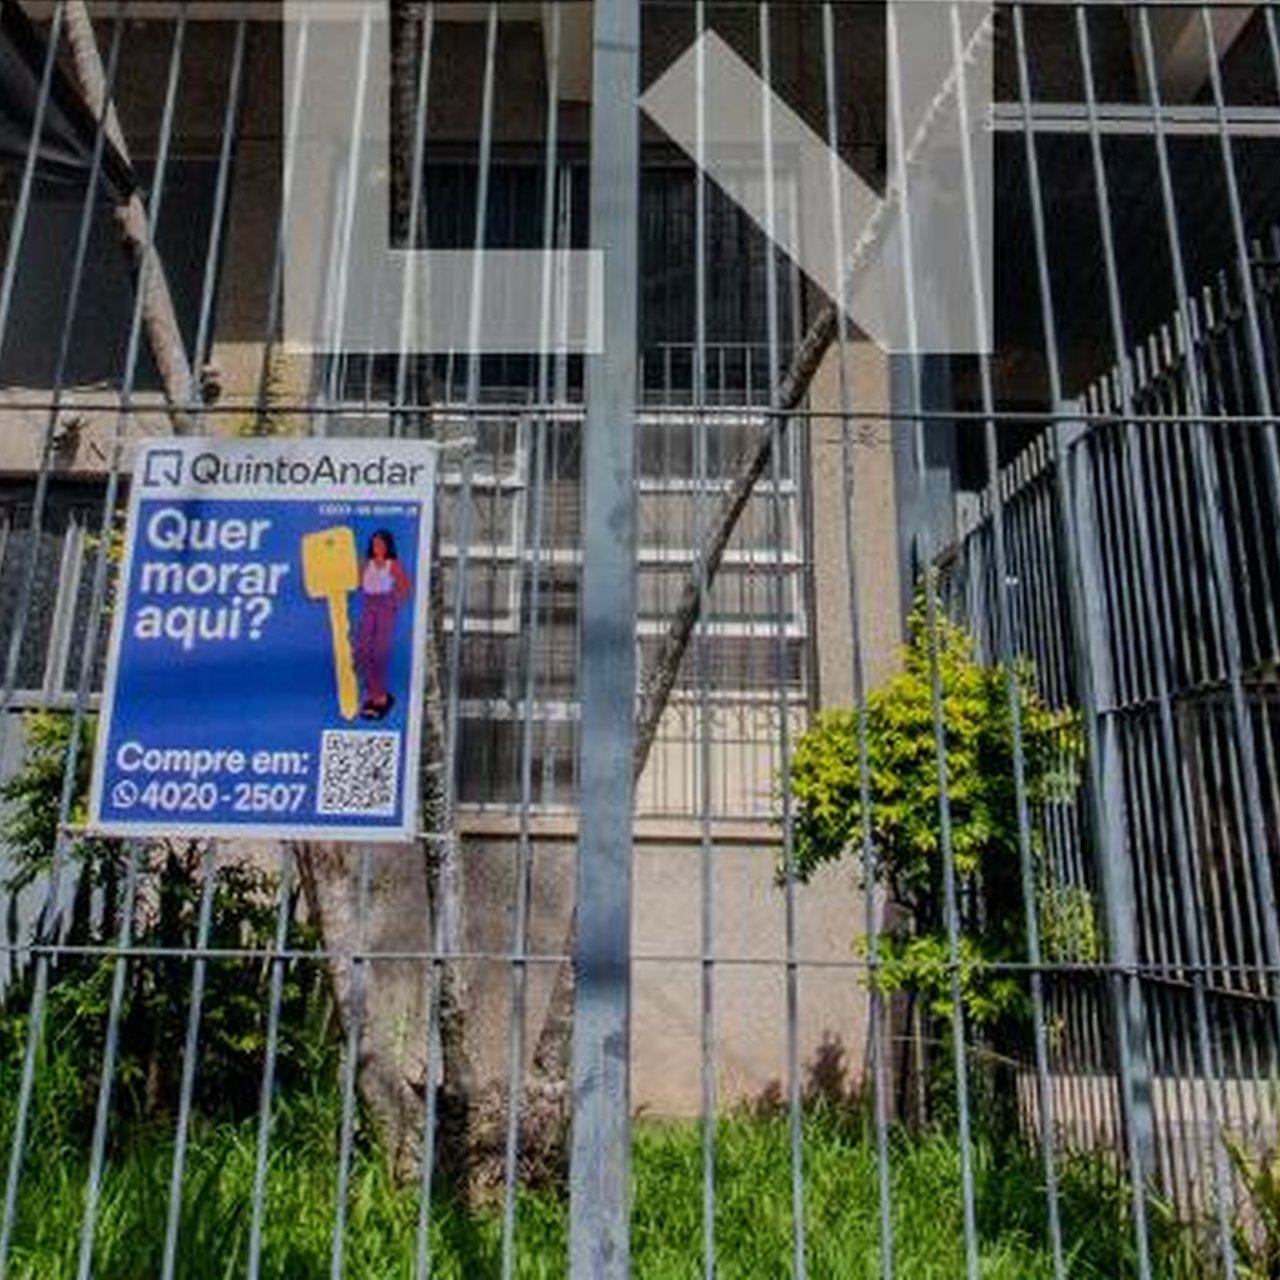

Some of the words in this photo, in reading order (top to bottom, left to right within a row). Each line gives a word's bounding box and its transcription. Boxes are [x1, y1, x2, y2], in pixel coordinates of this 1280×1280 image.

[191, 452, 424, 486] QuintoAndar
[146, 508, 271, 552] Quer
[139, 561, 289, 595] morar
[133, 597, 272, 650] aqui?
[116, 742, 245, 778] Compre
[251, 750, 310, 774] em:
